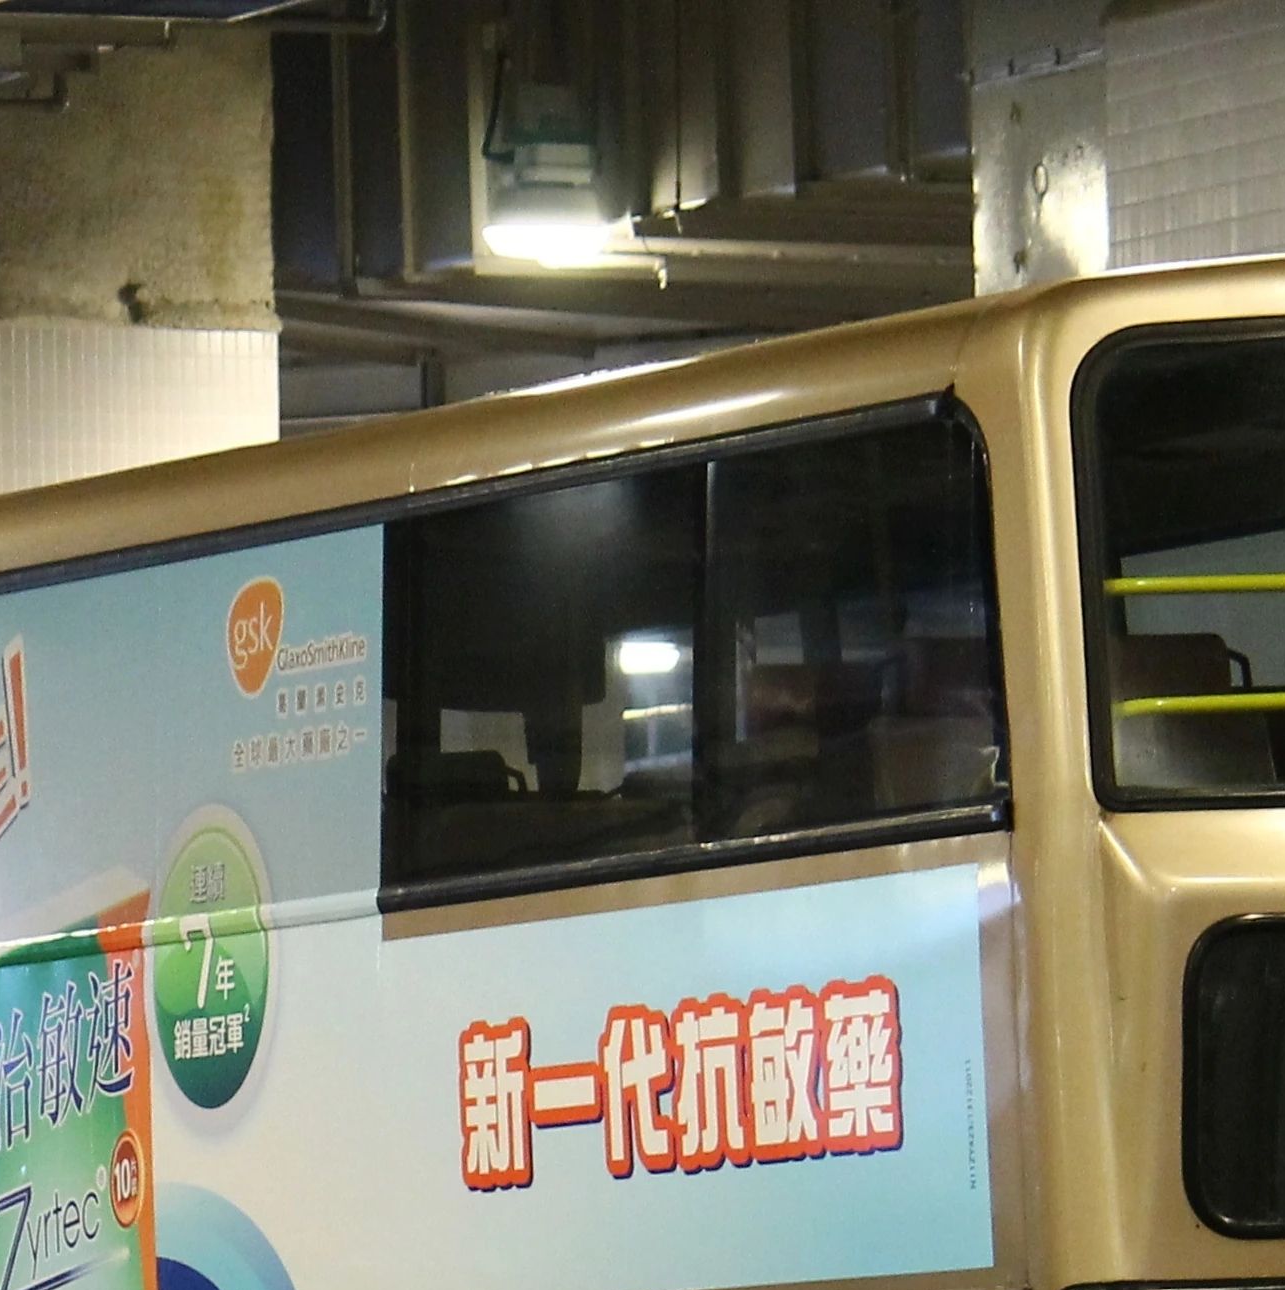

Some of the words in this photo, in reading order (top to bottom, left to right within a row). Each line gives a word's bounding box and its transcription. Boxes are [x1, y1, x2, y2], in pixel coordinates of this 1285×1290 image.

[233, 601, 274, 670] gsk
[276, 632, 366, 672] GlaxoSmithKline
[462, 982, 900, 1182] 新一代抗敏藥
